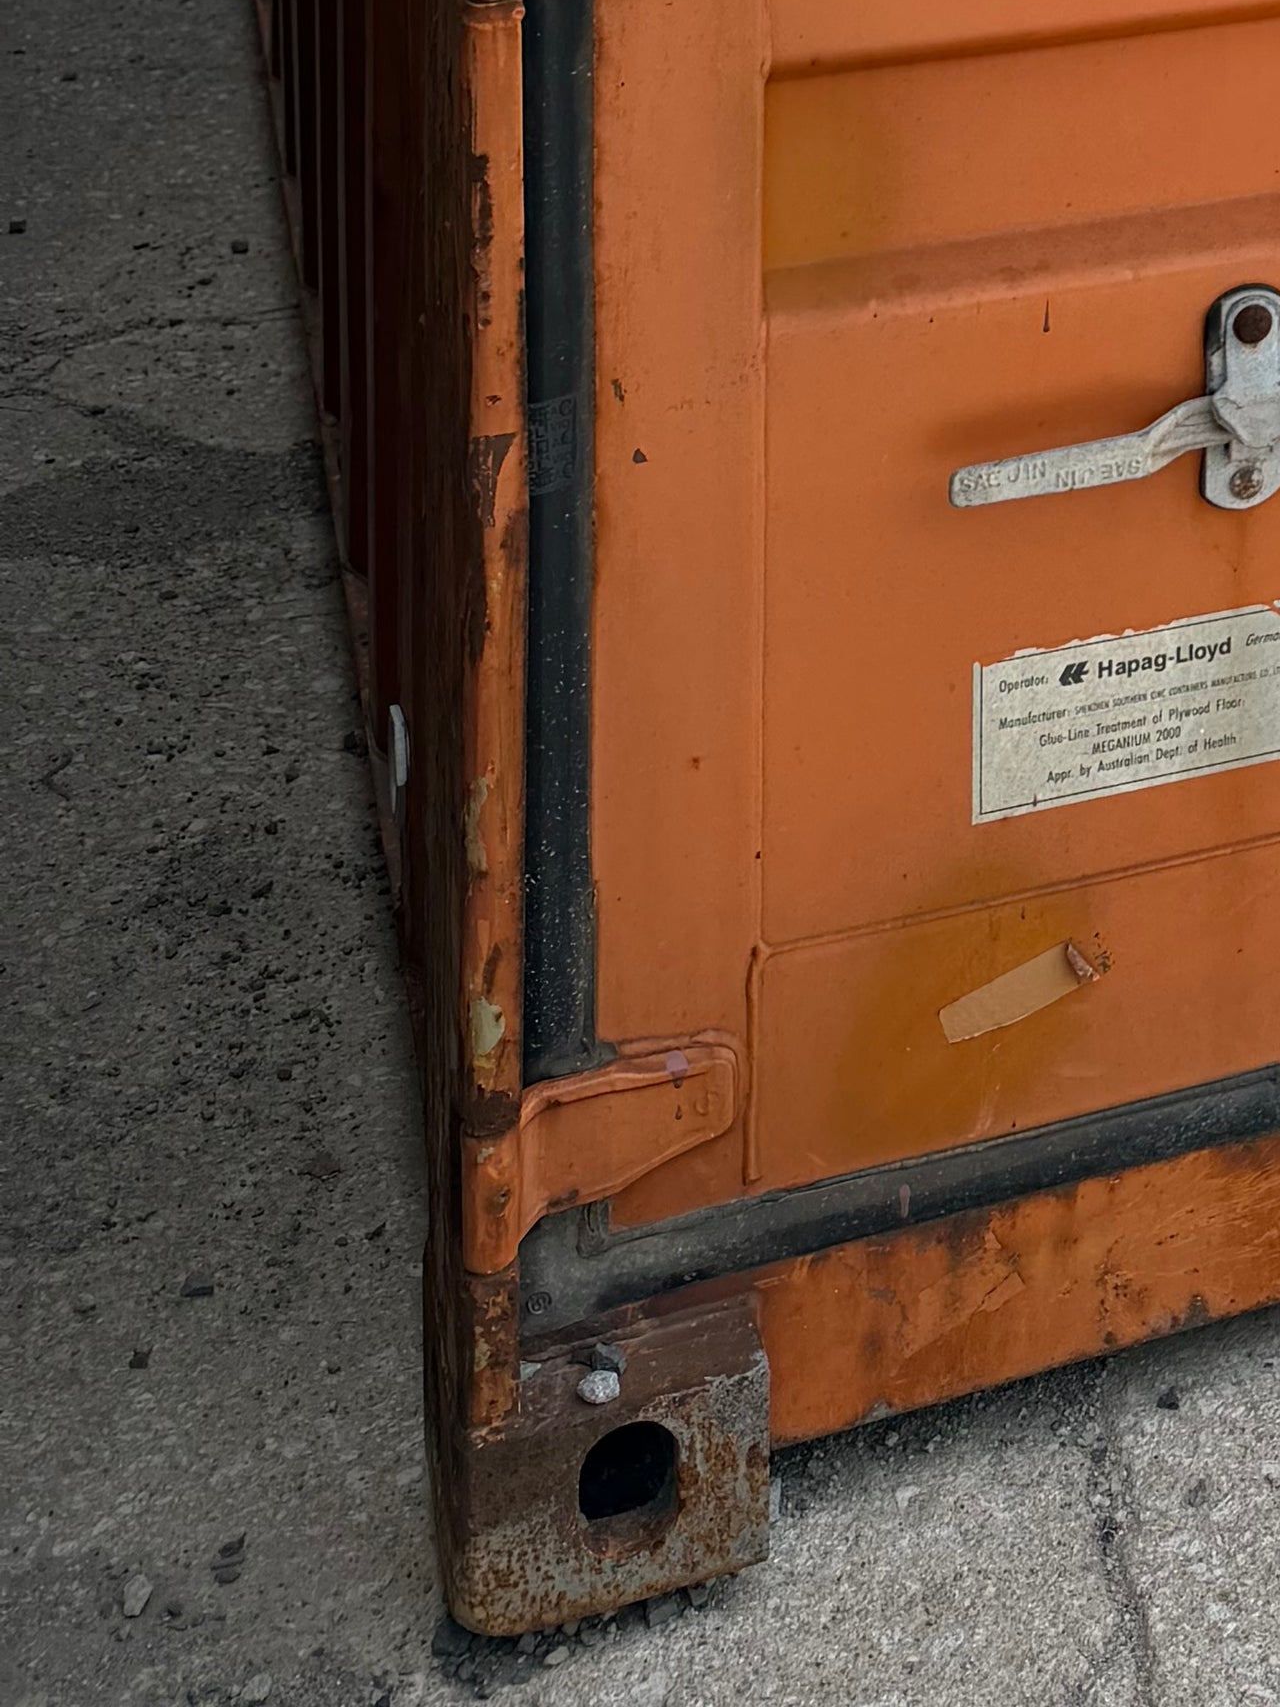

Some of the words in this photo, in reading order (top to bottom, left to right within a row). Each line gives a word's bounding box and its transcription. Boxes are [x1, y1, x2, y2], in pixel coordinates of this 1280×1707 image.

[998, 675, 1049, 695] Operator:
[1097, 636, 1232, 679] Hapag-Lloyd
[998, 708, 1071, 730] Manufacturer:
[1038, 728, 1090, 748] Glue-Line
[1096, 715, 1147, 736] Treatment
[1152, 709, 1164, 725] of
[1168, 700, 1211, 722] Plywood
[1091, 731, 1151, 755] MEGANIUM
[1155, 725, 1182, 743] 2000
[1079, 763, 1092, 778] by
[1097, 751, 1150, 773] Australian
[1188, 738, 1199, 754] of
[1203, 732, 1237, 751] Health
